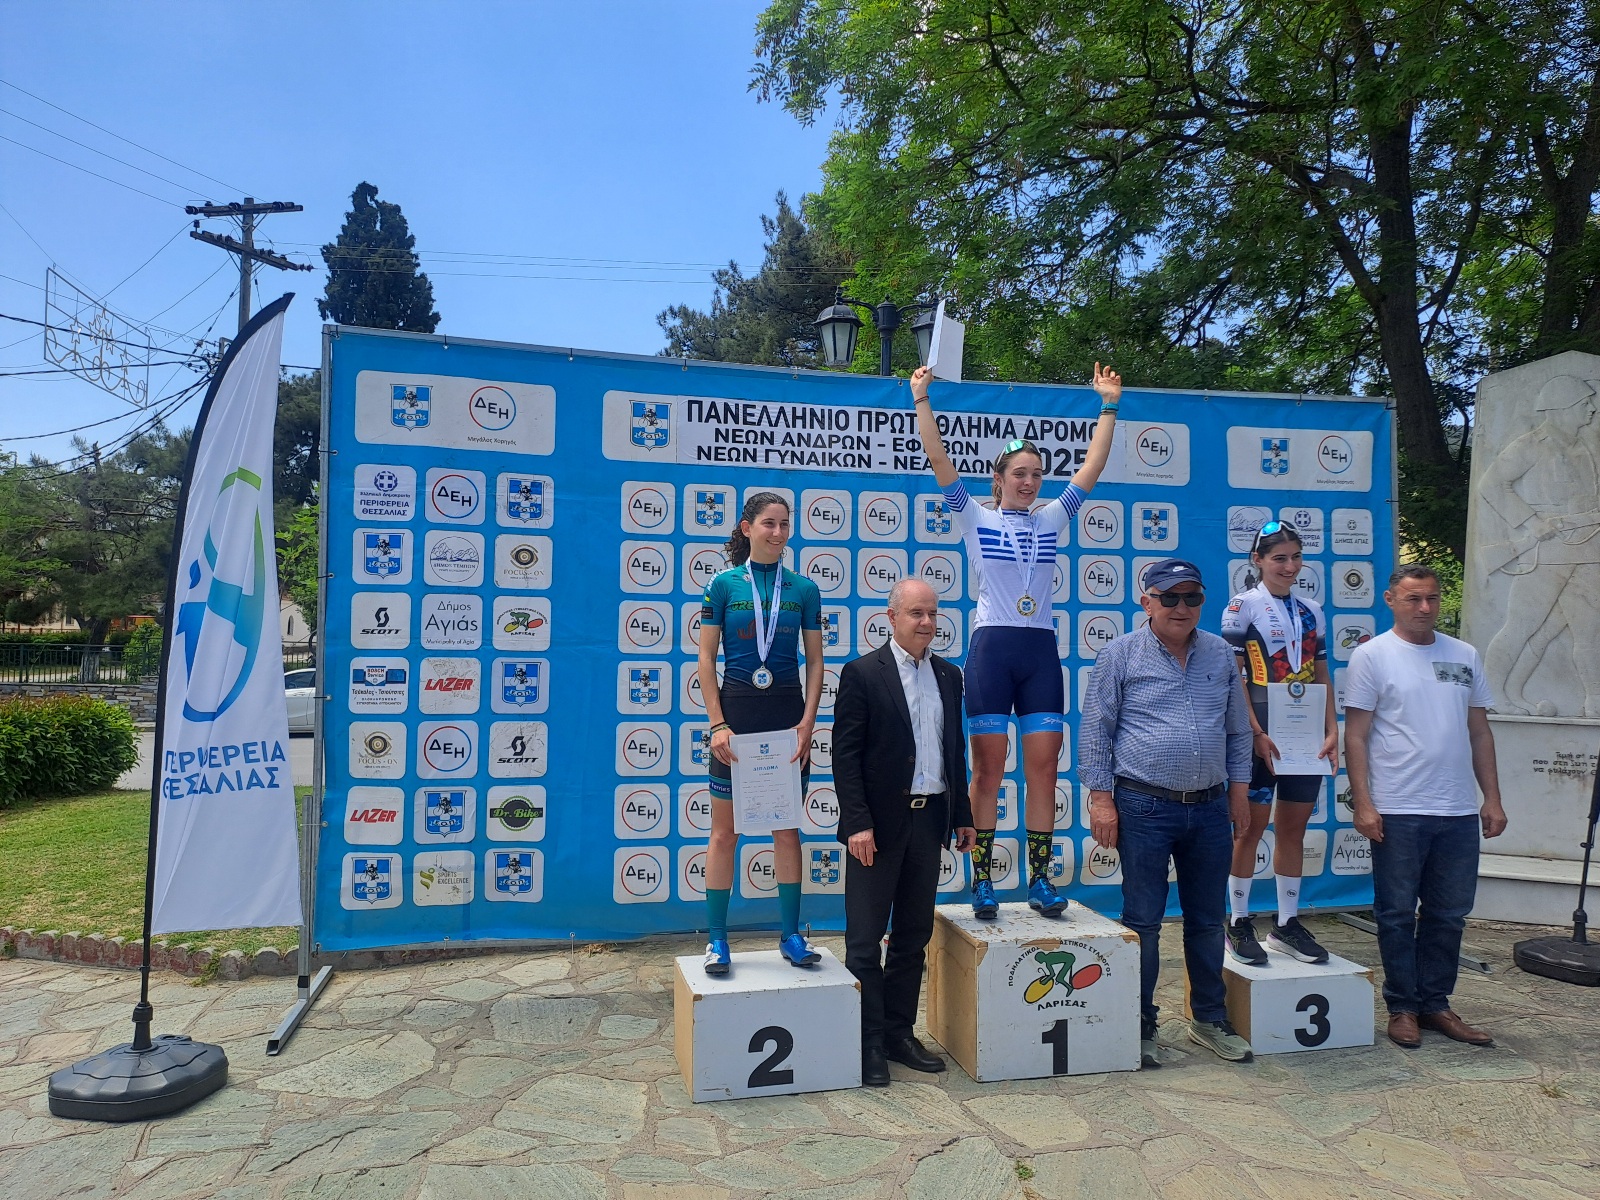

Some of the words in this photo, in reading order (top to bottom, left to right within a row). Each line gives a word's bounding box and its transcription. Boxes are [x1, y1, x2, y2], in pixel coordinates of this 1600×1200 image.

[474, 396, 509, 420] ΔΕΗ
[687, 399, 850, 431] ΠΑΝΕΛΛΗΝΙΟ
[857, 410, 1018, 440] ΠΡΩΤΘΛΗΜΑ
[1023, 419, 1116, 443] ΔΡΟΜΟ
[714, 428, 775, 446] ΝΕΩΝ
[781, 431, 871, 451] ΑΝΔΡΩΝ
[892, 437, 979, 456] ΕΦΒΩΝ
[1140, 437, 1169, 457] ΔΕΗ
[697, 445, 758, 463] ΝΕΩΝ
[764, 448, 872, 469] ΓΥΝΑΙΚΩΝ
[893, 455, 995, 474] ΝΕΑΙΔΩΝ
[1322, 445, 1348, 464] ΔΕΗ
[359, 499, 410, 508] ΠΕΡΙΦΕΡΕΙΑ
[437, 486, 472, 507] ΔΕΗ
[361, 507, 408, 517] ΘΕΣΣΑΛΙΑΣ
[632, 498, 662, 518] ΔΕΗ
[811, 506, 840, 524] ΔΕΗ
[868, 507, 896, 526] ΔΕΗ
[1088, 515, 1113, 533] ΔΕΗ
[631, 557, 661, 576] ΔΕΗ
[811, 563, 839, 582] ΔΕΗ
[868, 565, 896, 583] ΔΕΗ
[925, 566, 951, 584] ΔΕΗ
[1088, 570, 1113, 588] ΔΕΗ
[437, 600, 472, 613] Δήμος
[425, 613, 478, 636] Αγιάς
[630, 618, 660, 637] ΔΕΗ
[1088, 626, 1114, 642] ΔΕΗ
[424, 677, 473, 692] LAZER
[429, 739, 465, 759] ΔΕΗ
[627, 739, 658, 758] ΔΕΗ
[350, 808, 398, 823] LAZER
[514, 808, 540, 818] Bike
[626, 801, 657, 820] ΔΕΗ
[810, 799, 838, 817] ΔΕΗ
[1092, 852, 1116, 868] ΔΕΗ
[1334, 844, 1372, 863] Αγιάς
[625, 865, 656, 884] ΔΕΗ
[1037, 999, 1088, 1012] ΛΑΡΙΣΑΣ
[1294, 993, 1331, 1047] 3
[1041, 1019, 1069, 1075] 1
[747, 1025, 794, 1089] 2
